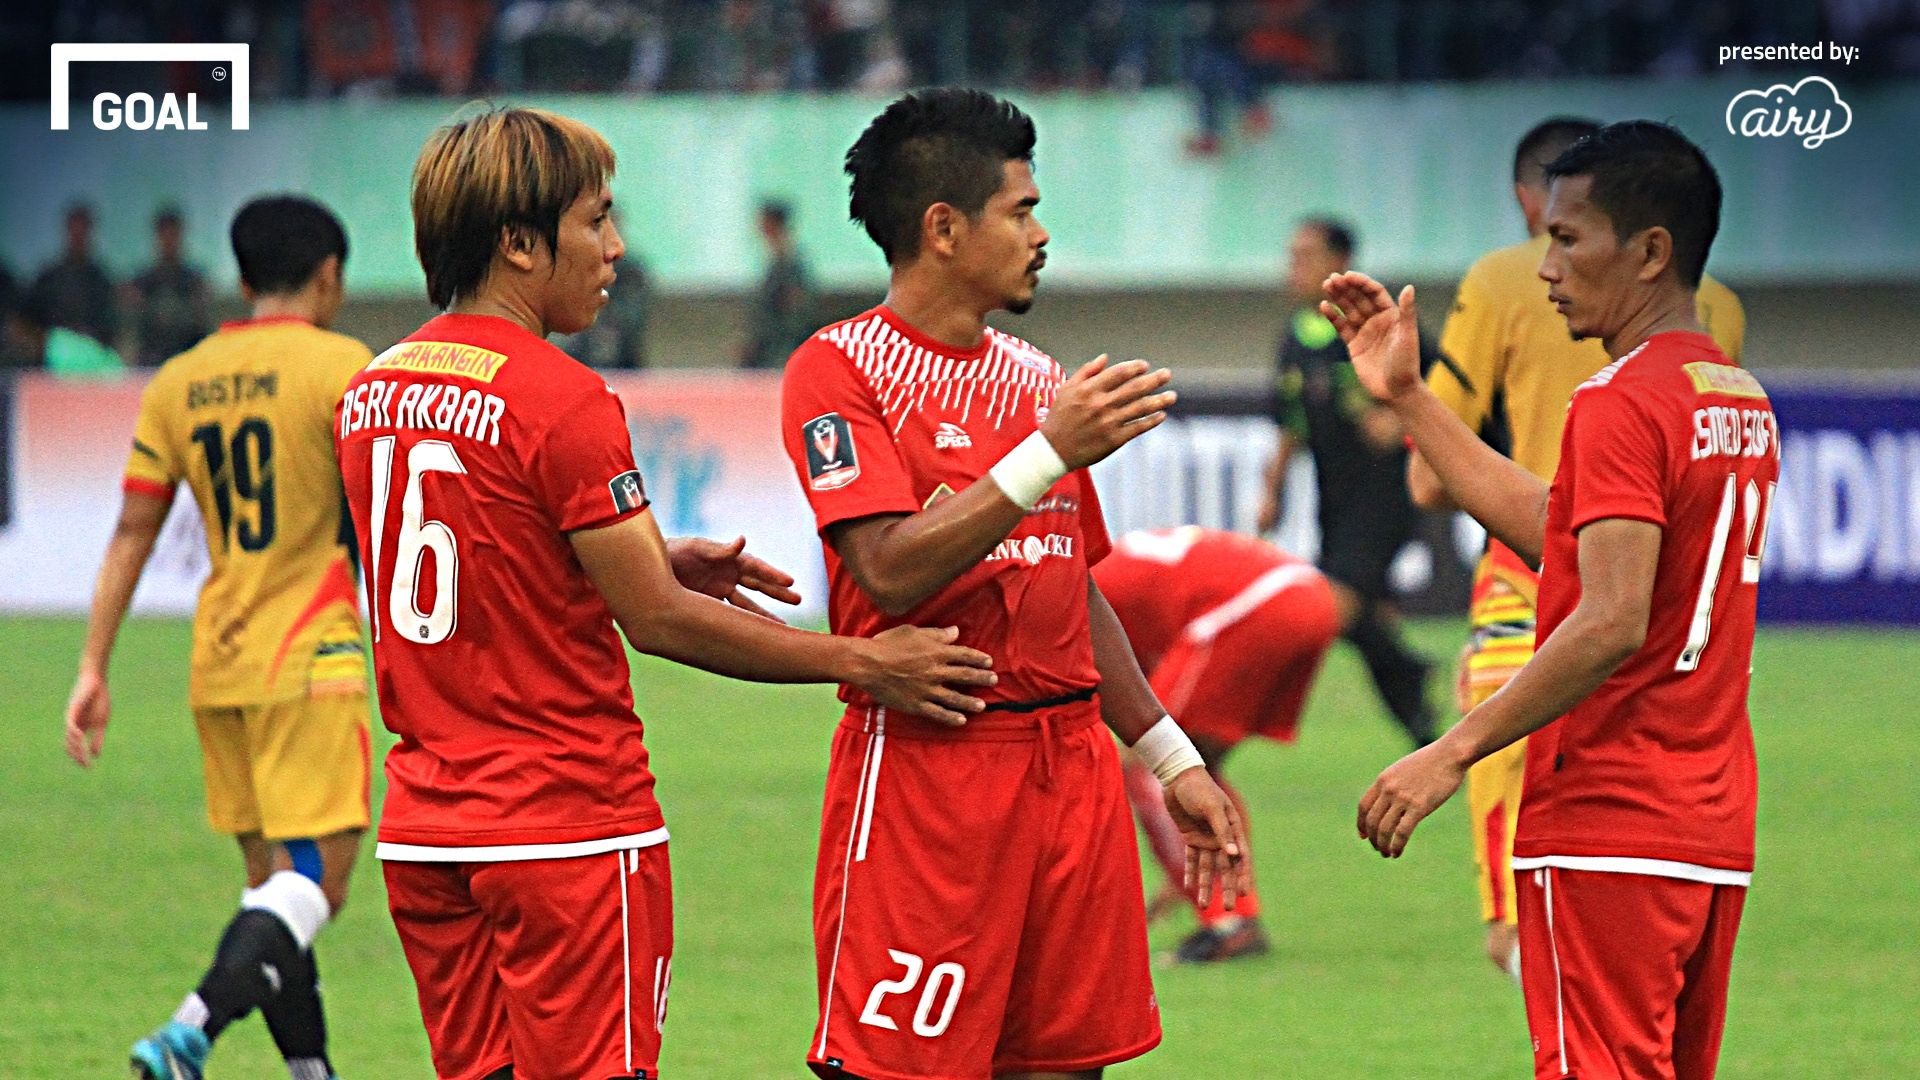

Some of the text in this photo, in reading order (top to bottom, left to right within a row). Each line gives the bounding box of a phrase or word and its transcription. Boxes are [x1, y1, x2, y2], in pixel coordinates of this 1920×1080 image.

[341, 380, 505, 447] ASRI AKBAR
[934, 433, 973, 449] SPECS
[191, 416, 275, 553] 19
[369, 435, 468, 645] 16
[858, 947, 967, 1038] 20
